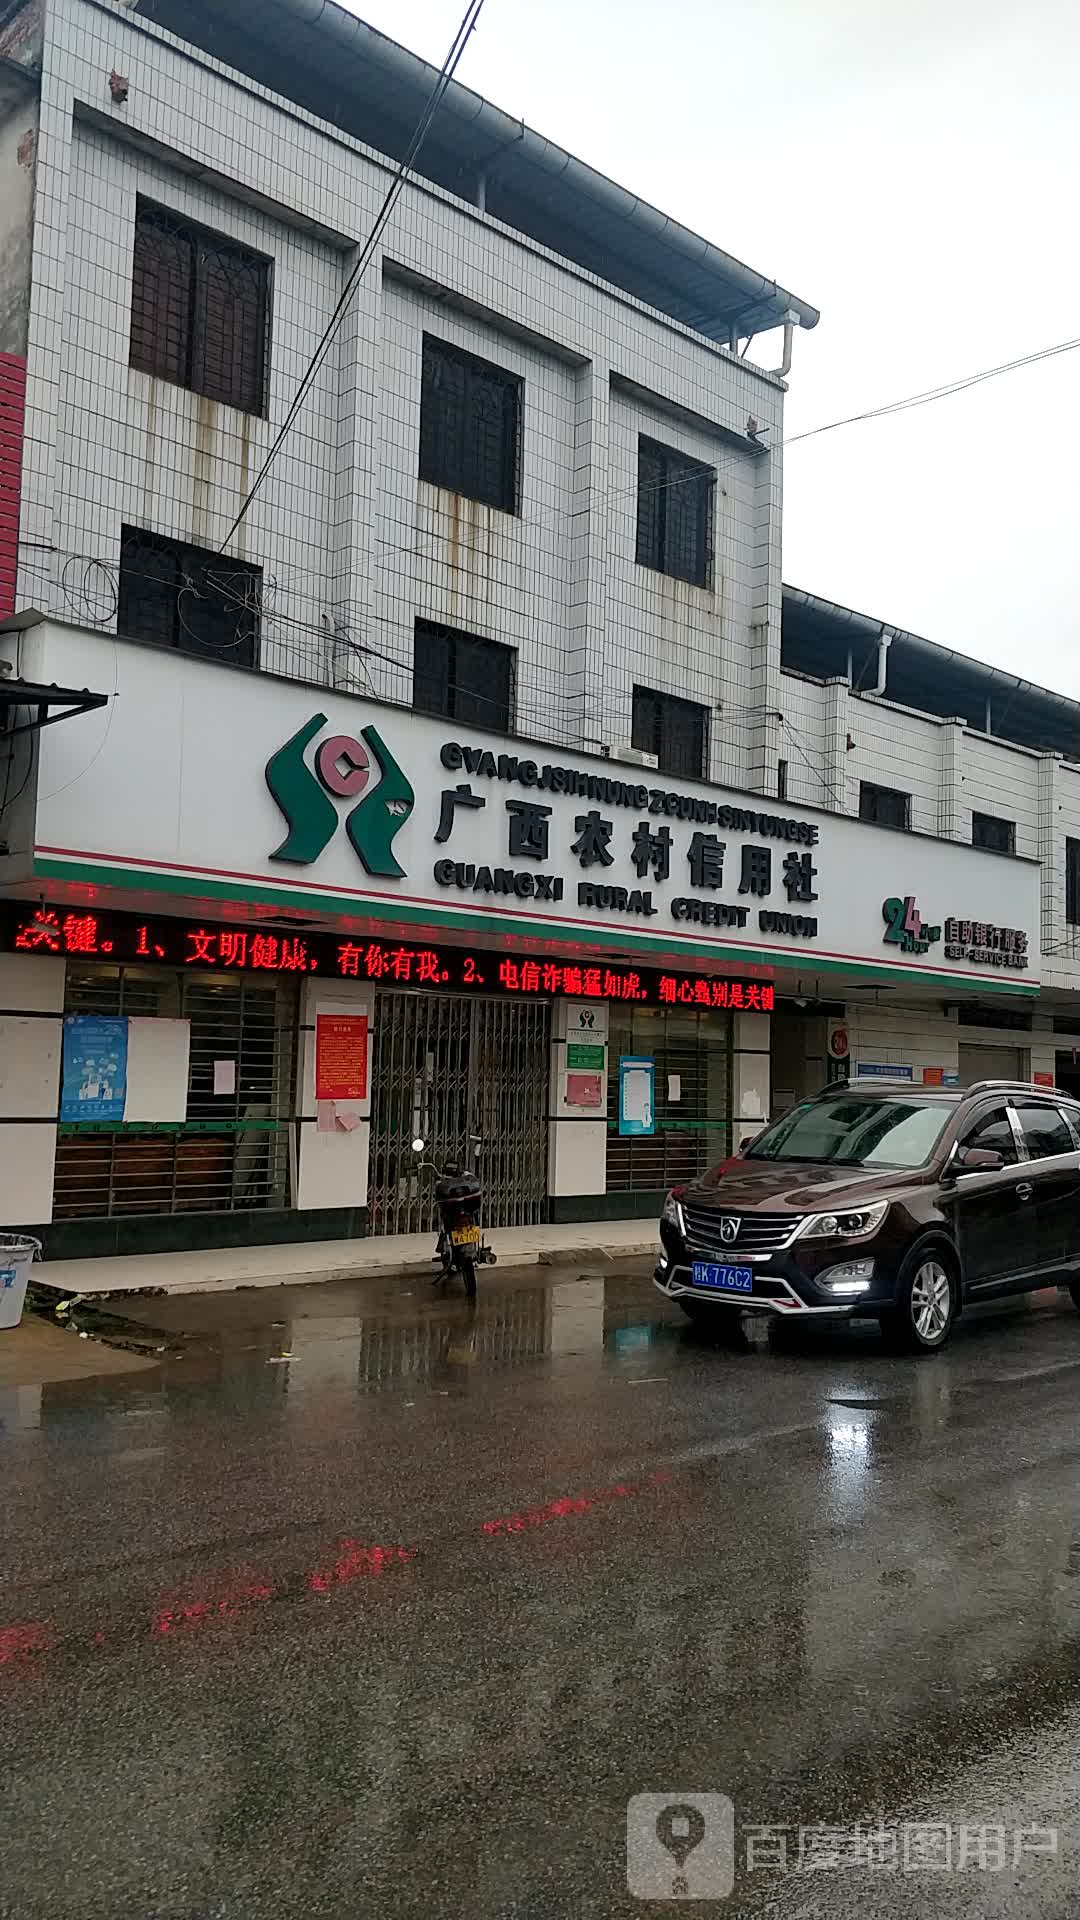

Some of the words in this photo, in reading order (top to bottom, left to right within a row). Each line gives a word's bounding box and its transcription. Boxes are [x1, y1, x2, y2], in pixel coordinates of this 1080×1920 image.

[432, 783, 818, 904] 广西农村信用社
[432, 857, 564, 901] GUANGXI
[576, 882, 658, 915] RURAL
[670, 897, 751, 928] CREDIT
[758, 909, 818, 938] UNION
[882, 896, 921, 944] 24
[944, 917, 1029, 952] 自助银行服务
